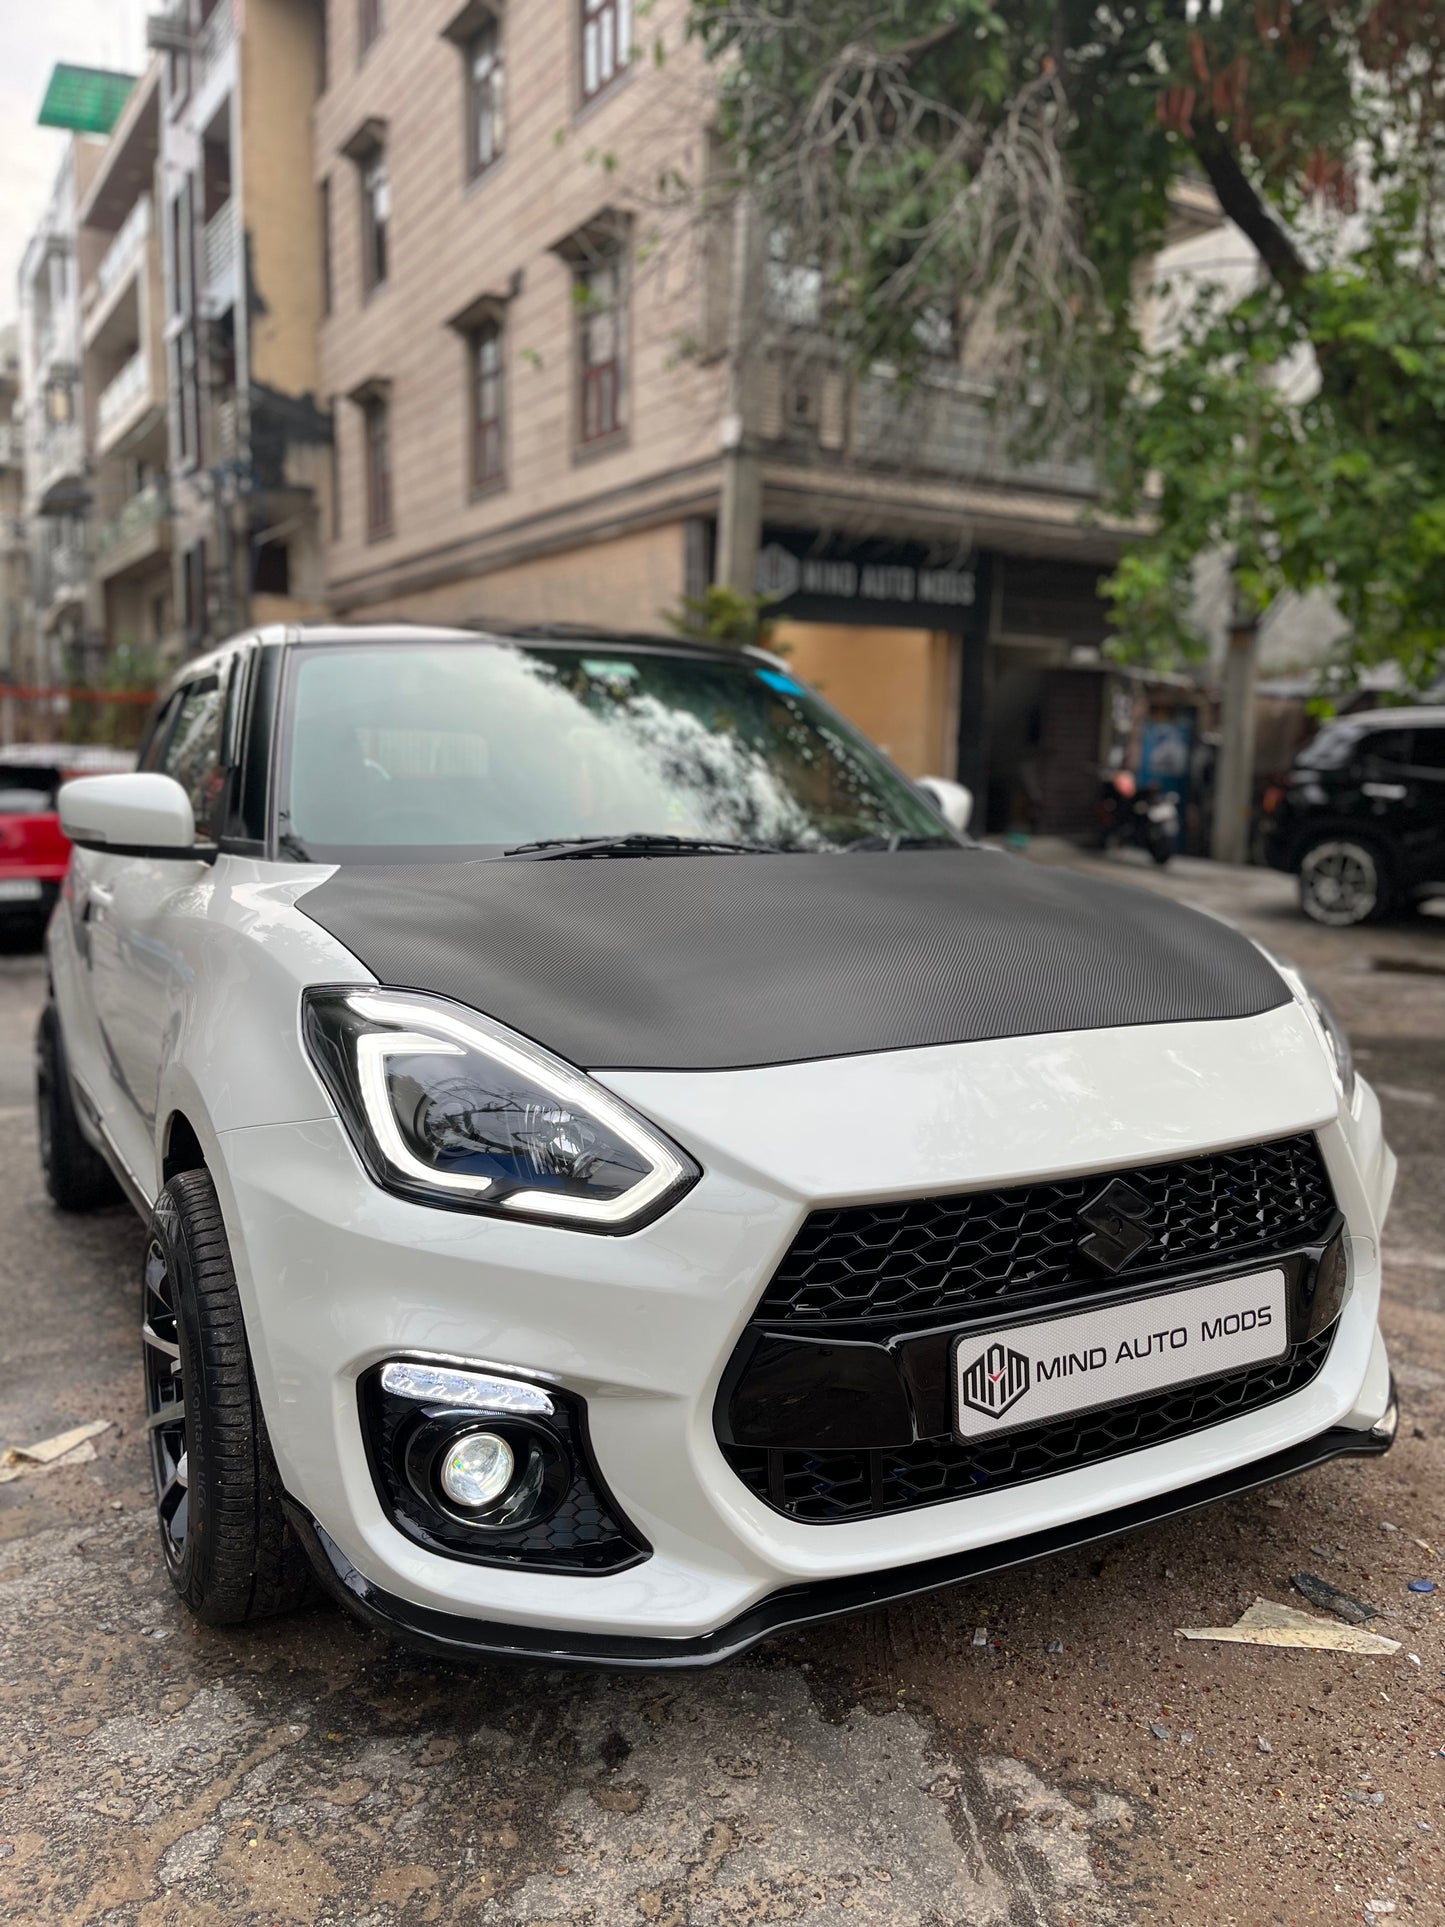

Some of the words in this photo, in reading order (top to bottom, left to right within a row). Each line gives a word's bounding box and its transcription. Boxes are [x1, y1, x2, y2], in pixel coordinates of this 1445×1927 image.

[1036, 1347, 1107, 1382] MIND
[1115, 1327, 1187, 1363] AUTO
[1201, 1305, 1272, 1341] MODS
